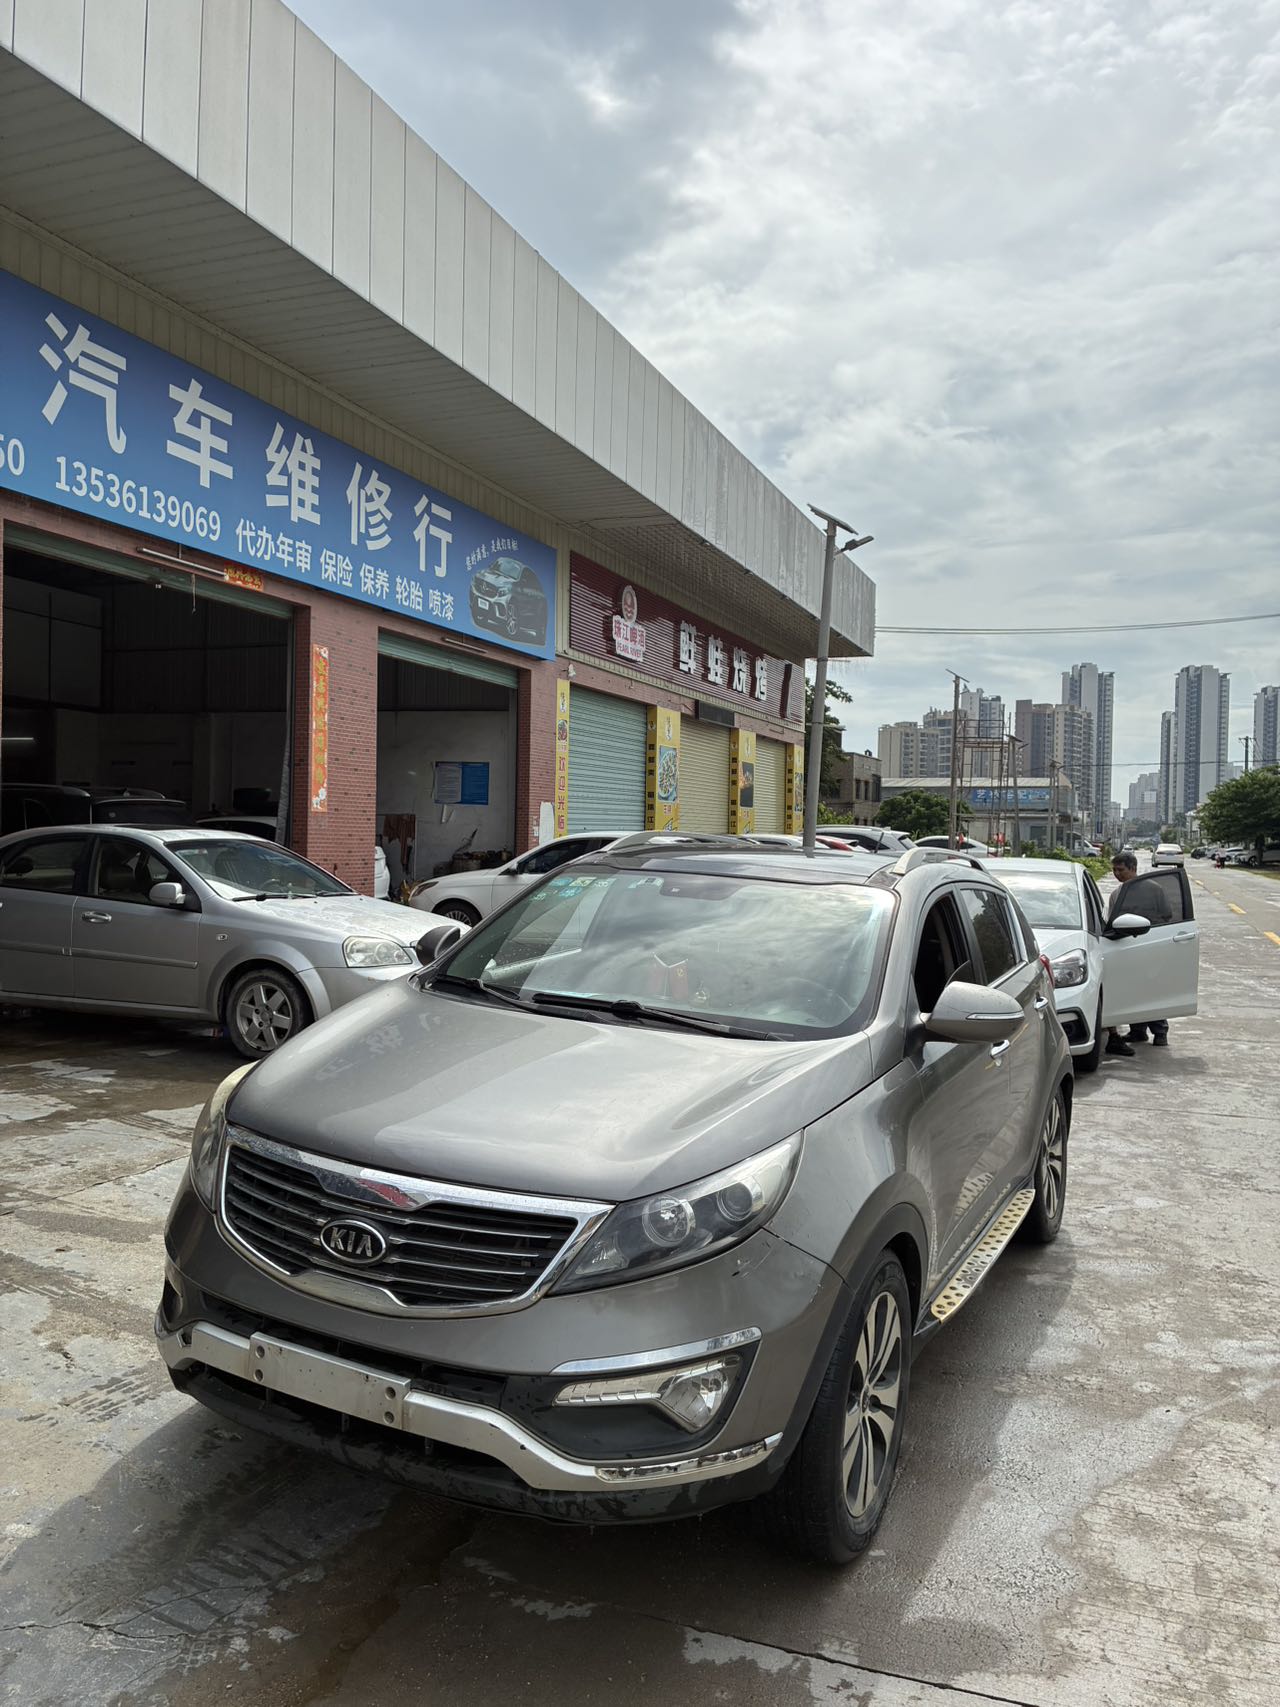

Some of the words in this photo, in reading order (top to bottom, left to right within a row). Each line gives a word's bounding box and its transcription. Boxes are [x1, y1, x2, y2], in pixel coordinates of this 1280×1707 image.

[38, 311, 454, 578] 汽车维修行
[55, 455, 221, 542] 13536139069
[236, 517, 313, 574] 代办年审
[320, 547, 354, 588] 保险
[359, 562, 390, 600] 保养
[395, 575, 424, 612] 轮胎
[429, 589, 455, 622] 喷漆
[329, 1226, 373, 1257] KIA
